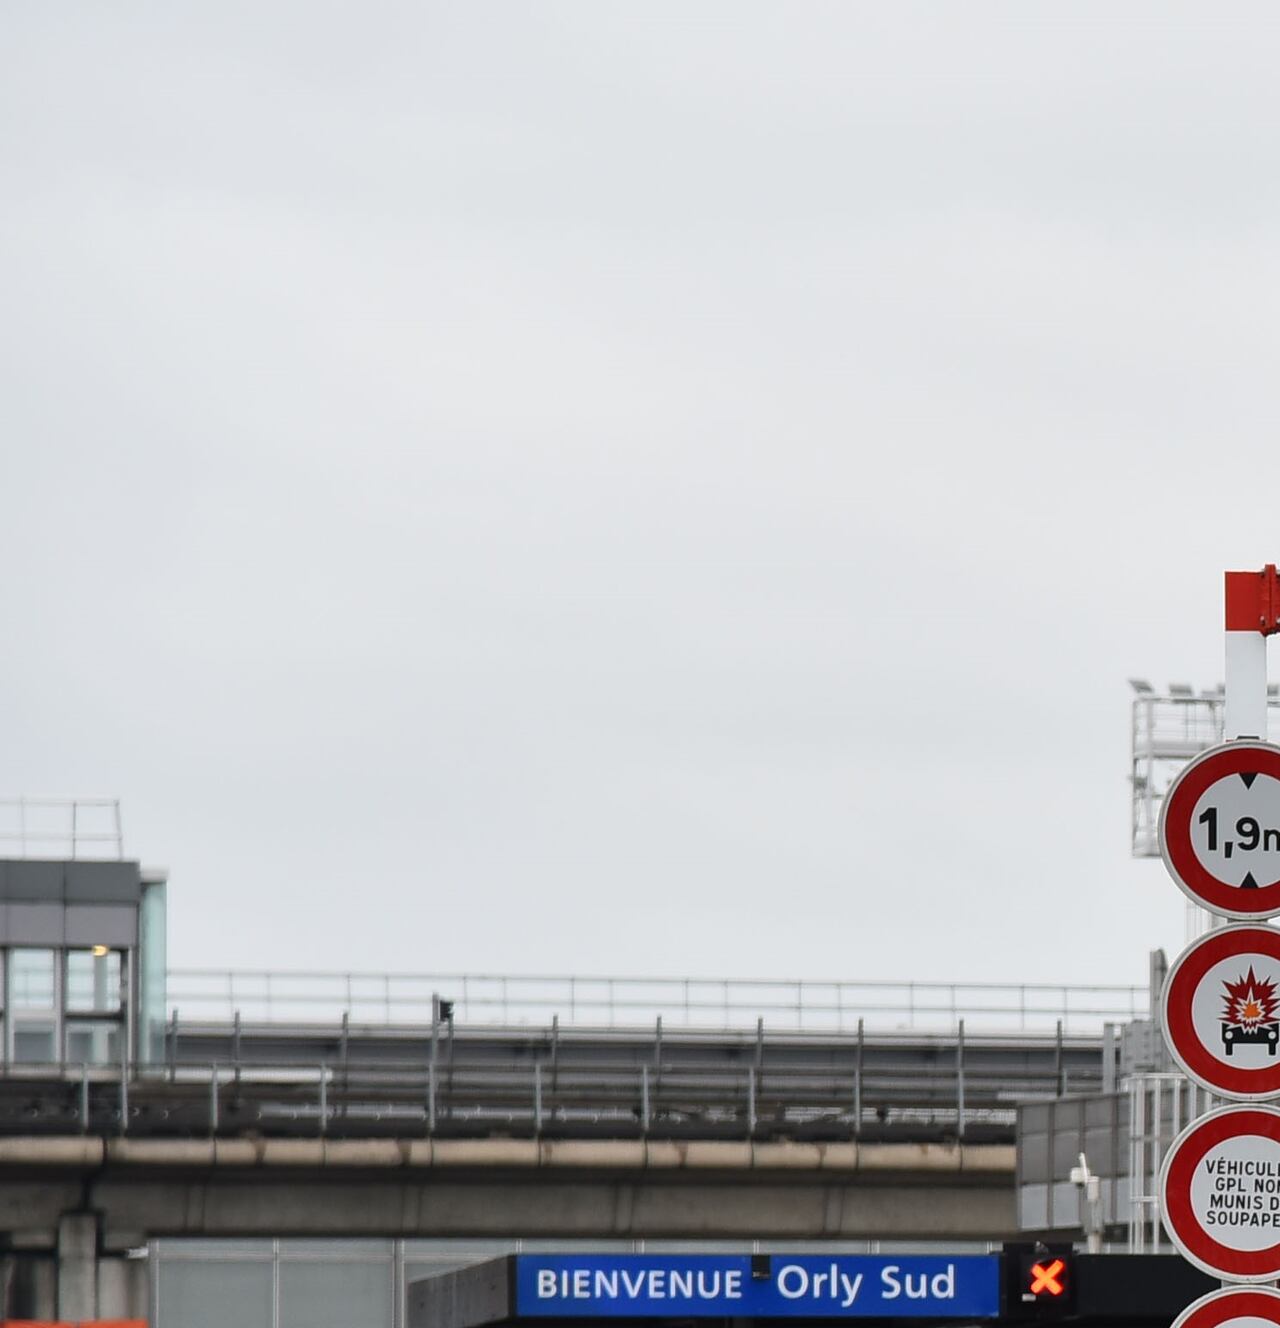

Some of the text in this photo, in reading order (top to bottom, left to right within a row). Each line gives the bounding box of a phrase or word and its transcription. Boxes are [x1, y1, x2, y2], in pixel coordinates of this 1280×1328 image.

[1215, 1177, 1247, 1193] GPL
[1210, 1193, 1263, 1210] MUNIS
[537, 1263, 956, 1307] BIENVENUE Orly Sud
